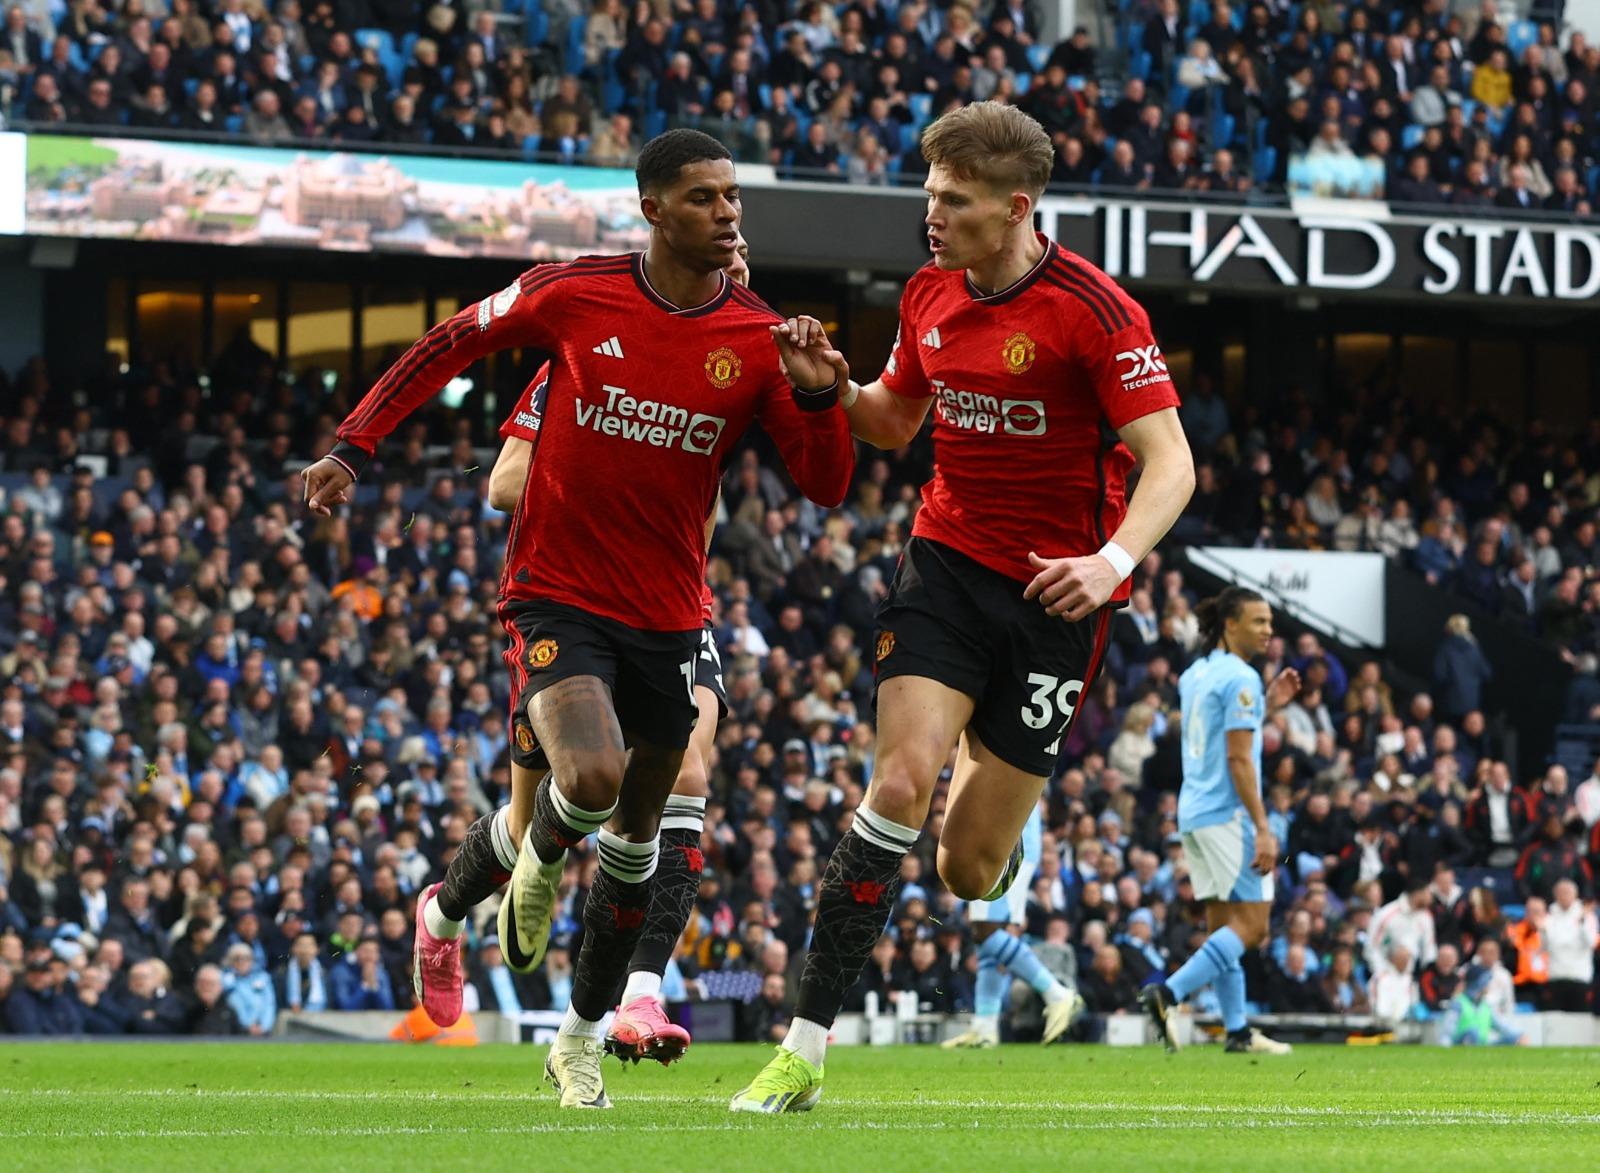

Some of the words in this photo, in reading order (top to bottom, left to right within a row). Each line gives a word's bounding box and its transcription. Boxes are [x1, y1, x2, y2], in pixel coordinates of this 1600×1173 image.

[1423, 222, 1600, 299] STAD
[602, 384, 688, 428] Team
[931, 379, 999, 414] Team
[576, 397, 682, 448] Viewer
[1021, 672, 1085, 734] 39
